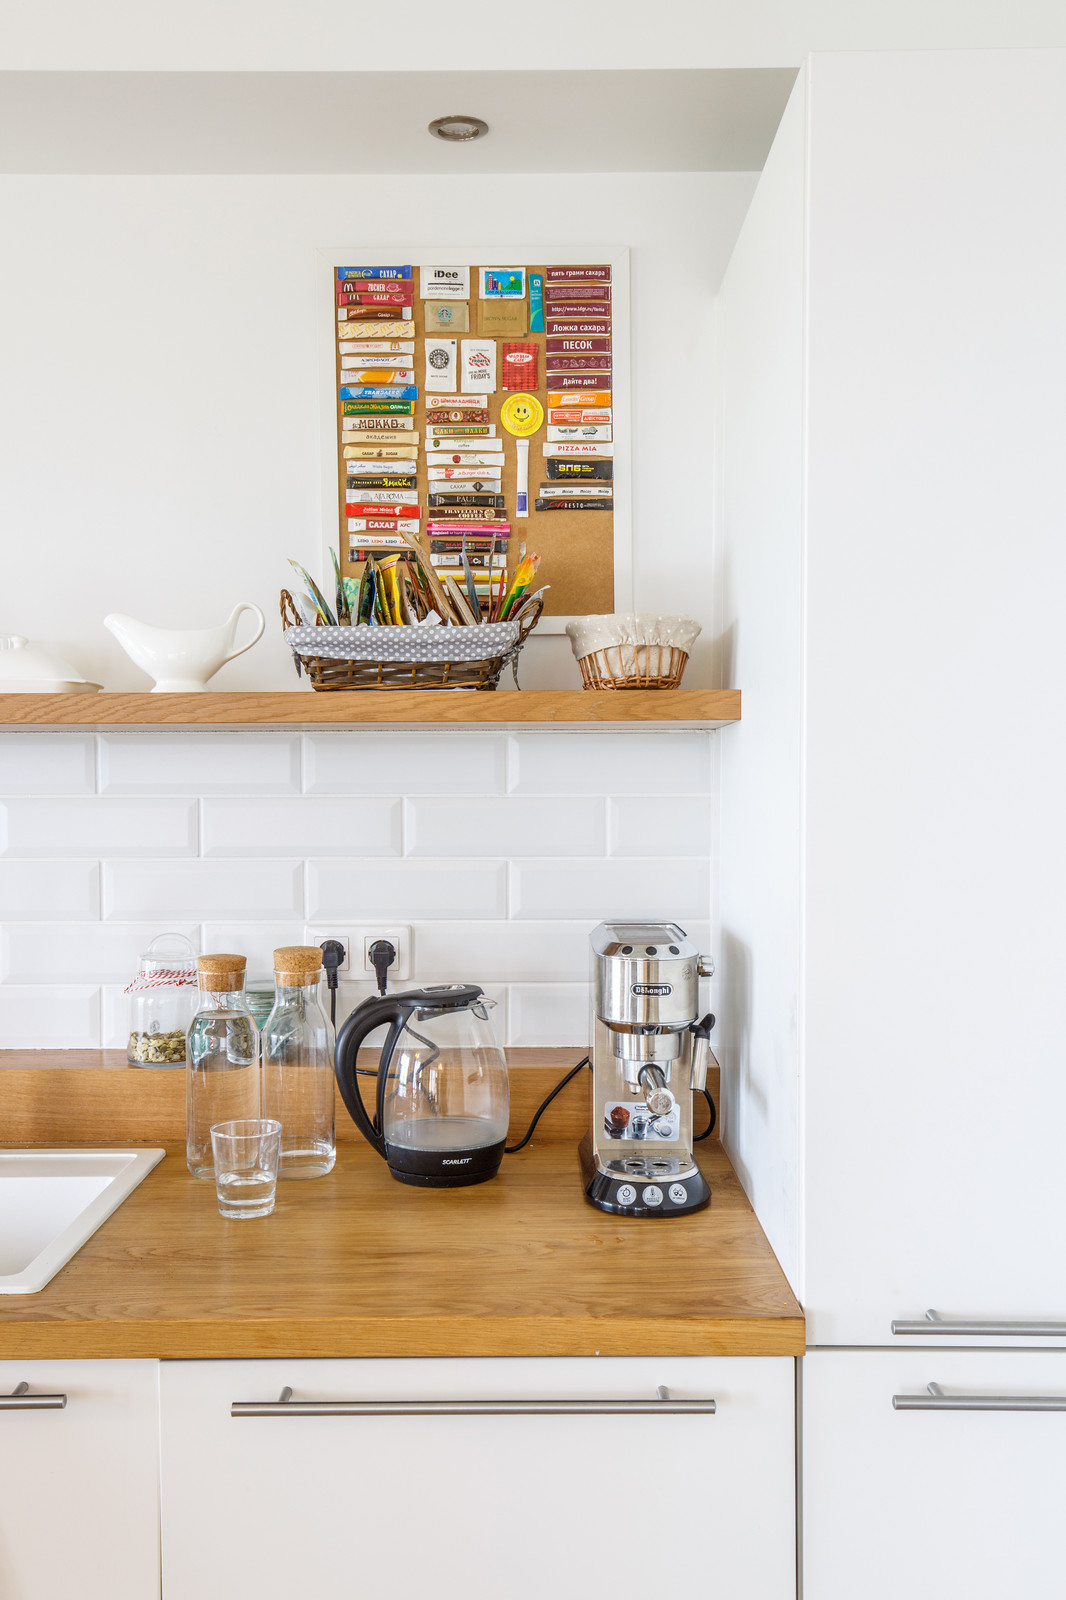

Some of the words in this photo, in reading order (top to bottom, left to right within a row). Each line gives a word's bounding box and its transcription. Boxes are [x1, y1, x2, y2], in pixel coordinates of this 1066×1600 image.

[379, 270, 397, 278] САХАР
[434, 270, 459, 279] iDee
[367, 283, 386, 292] ZUCKER
[552, 324, 579, 332] Ложка
[579, 324, 606, 333] сахара
[563, 340, 593, 350] ПЕСОК
[562, 378, 583, 386] Дайте
[582, 377, 598, 386] два!
[359, 419, 399, 429] МОККО
[368, 520, 396, 530] САХАР
[441, 1157, 473, 1166] SCARLETT
